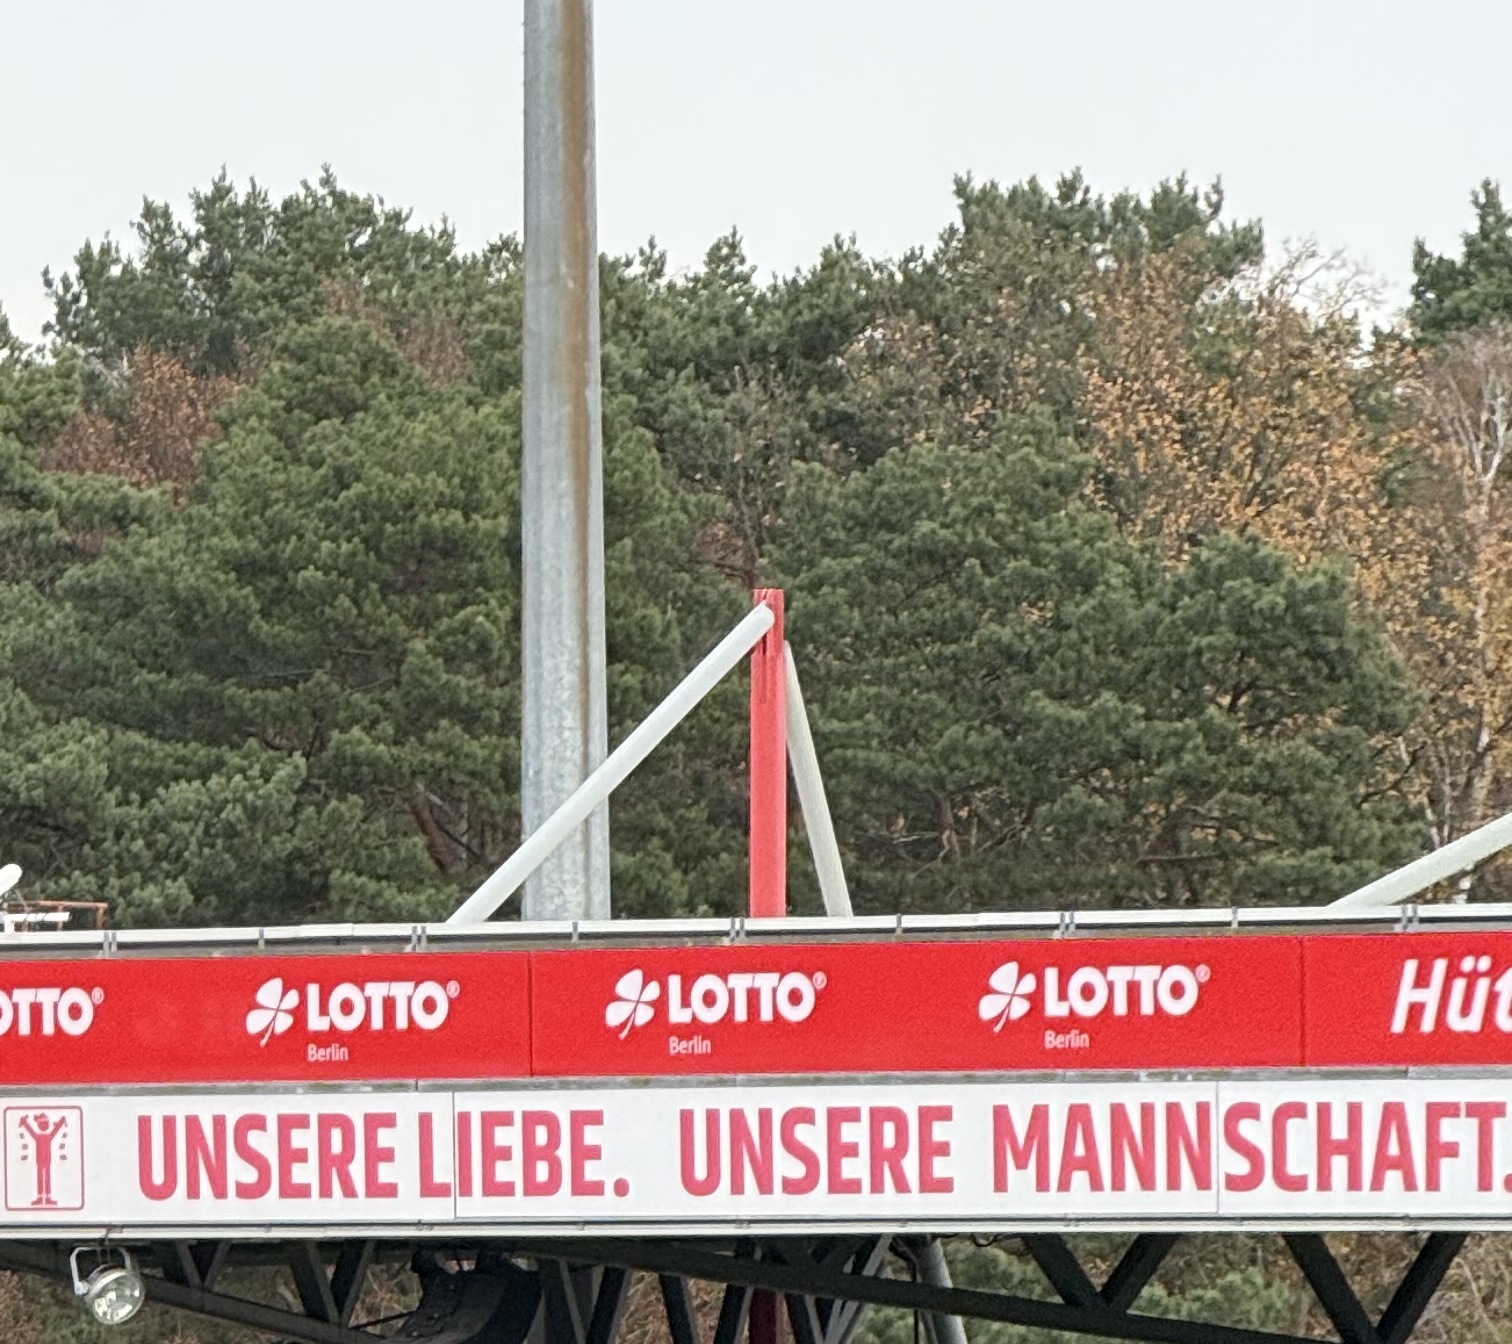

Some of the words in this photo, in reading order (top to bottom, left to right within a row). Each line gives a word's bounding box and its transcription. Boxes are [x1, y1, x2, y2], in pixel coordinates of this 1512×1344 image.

[307, 980, 450, 1032] LOTTO
[668, 971, 815, 1024] LOTTO
[1044, 964, 1199, 1018] LOTTO
[307, 1042, 349, 1061] Berlin
[669, 1036, 711, 1055] Berlin
[1044, 1030, 1089, 1049] Berlin
[138, 1112, 398, 1201] UNSERE
[417, 1110, 630, 1199] LIEBE.
[680, 1106, 954, 1197] UNSERE
[993, 1101, 1512, 1193] MANNSCHAFT.
